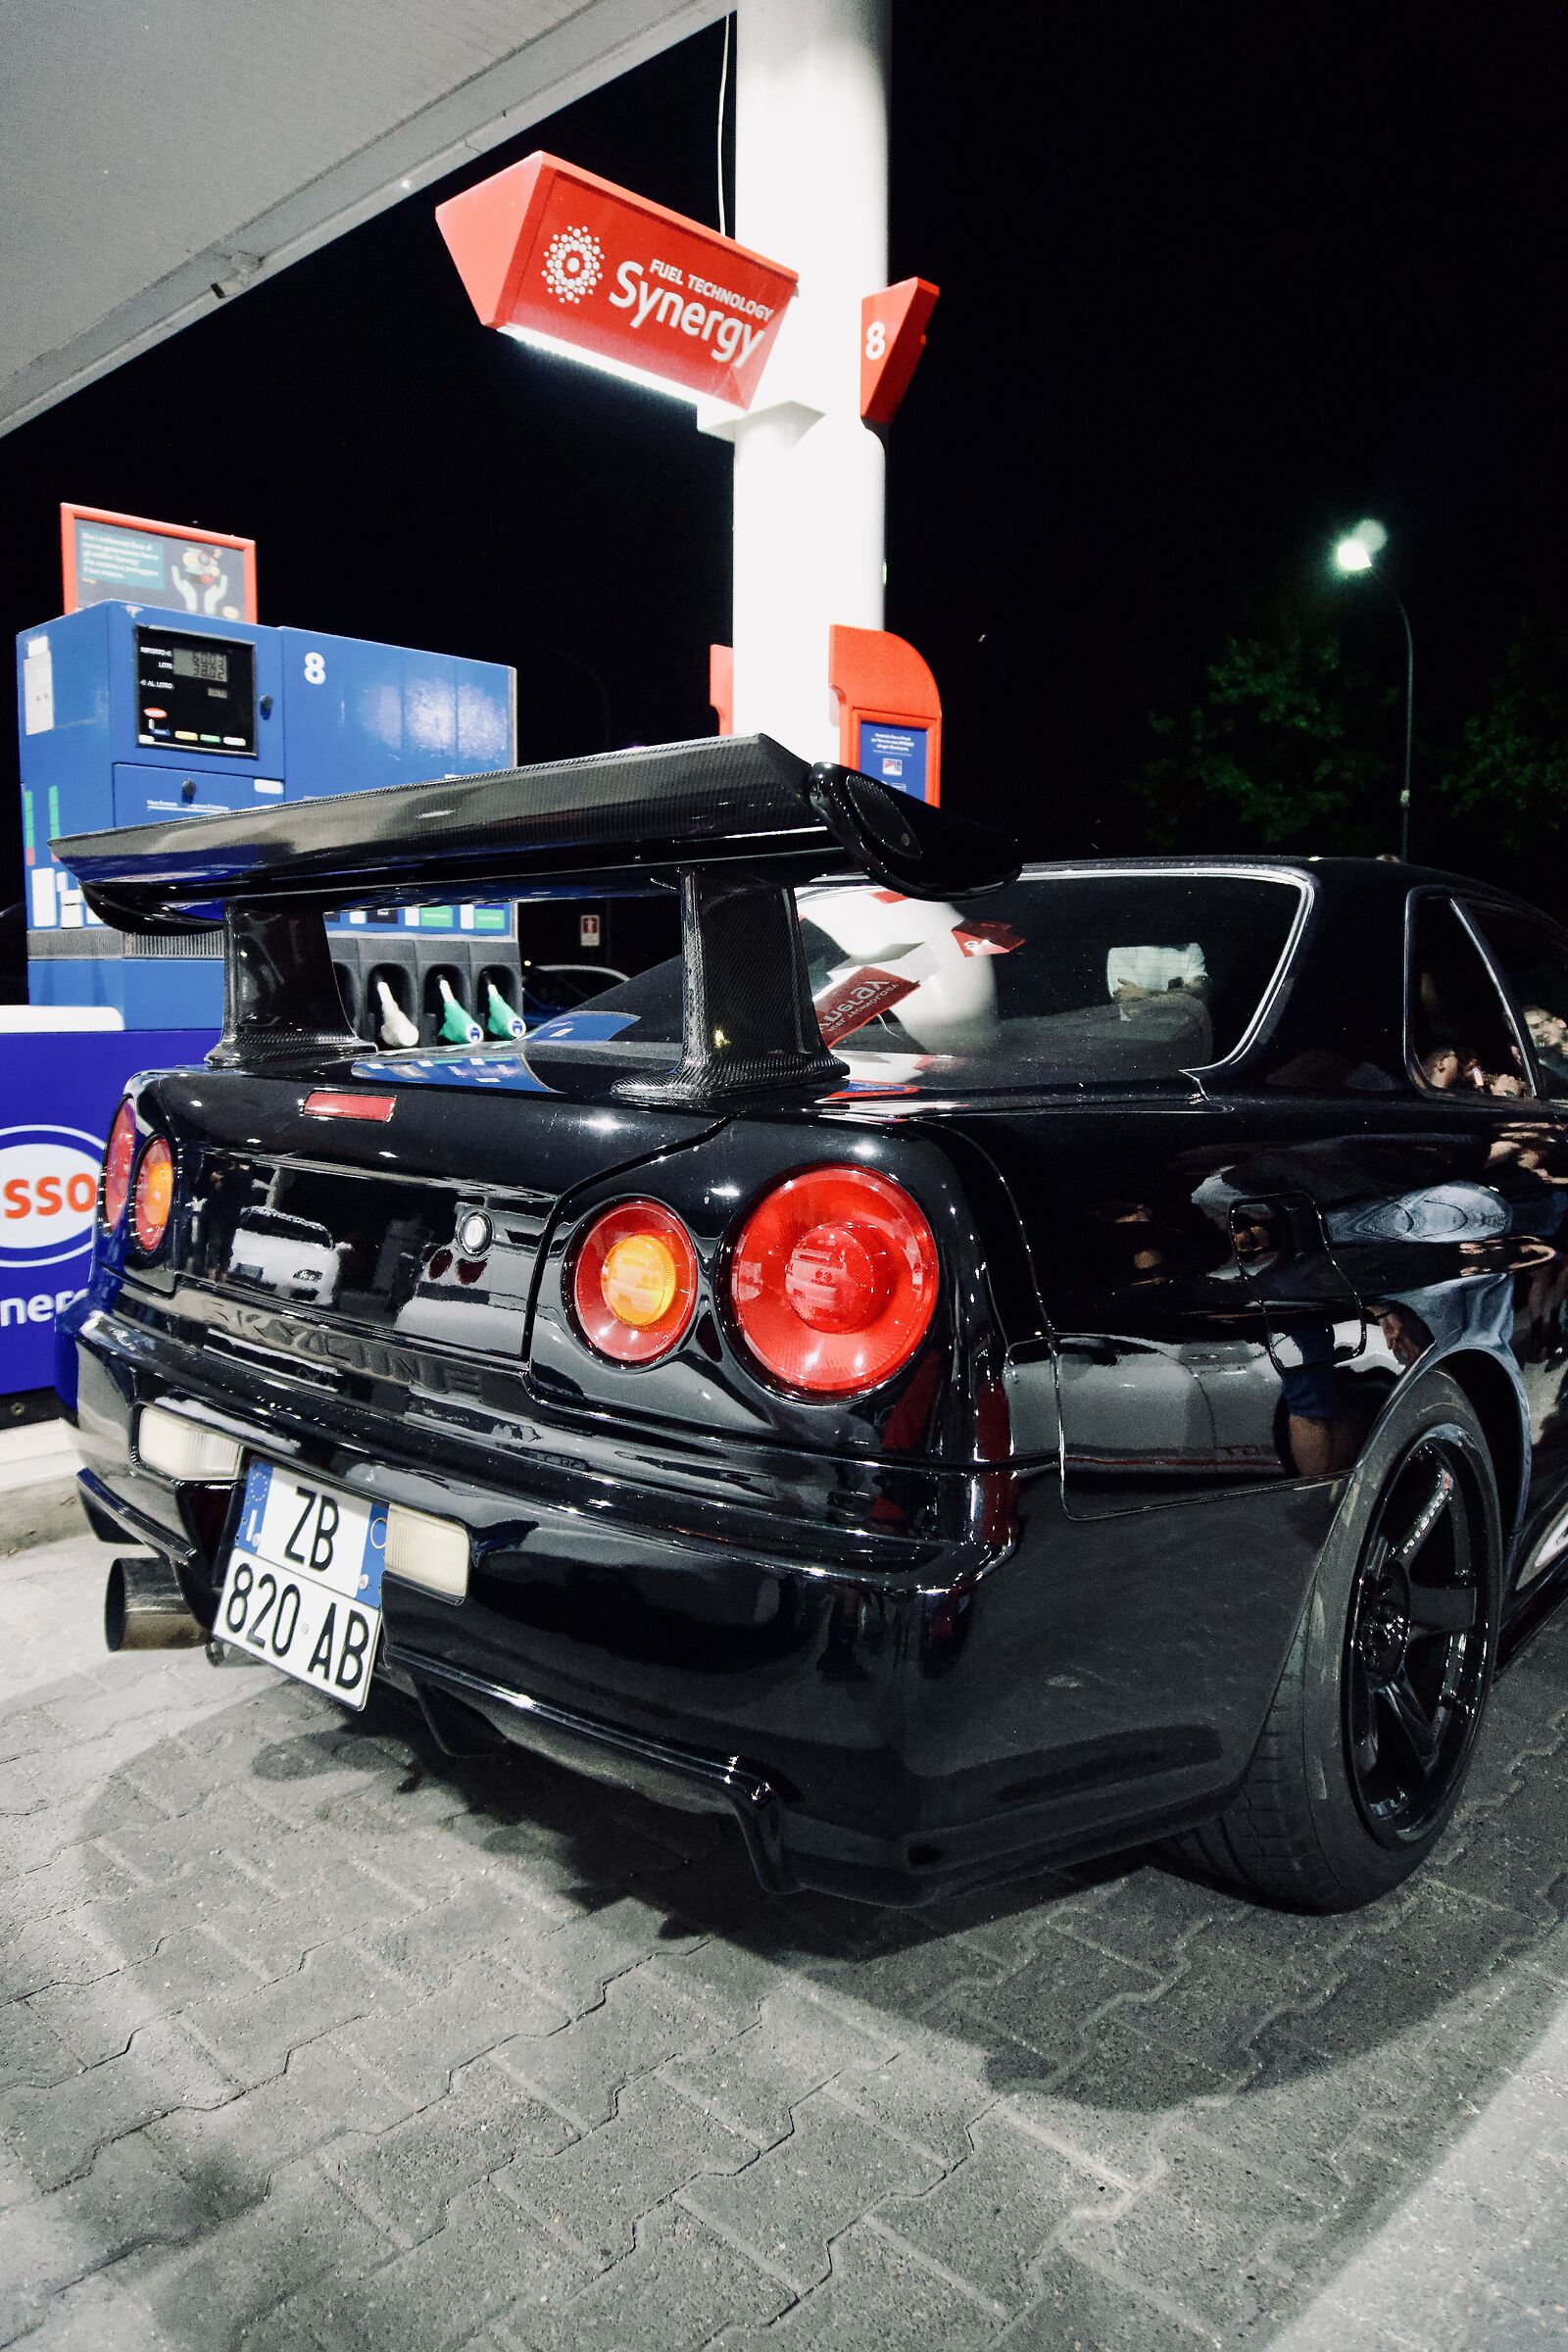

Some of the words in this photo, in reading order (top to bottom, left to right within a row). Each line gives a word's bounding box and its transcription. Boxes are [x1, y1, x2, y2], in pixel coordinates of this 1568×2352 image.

[609, 260, 766, 368] Synergy
[649, 259, 683, 285] FUEL
[687, 273, 774, 321] TECHNOLOGY
[865, 321, 886, 361] 8
[304, 652, 326, 685] 8
[3, 1173, 97, 1219] SSO
[200, 1298, 483, 1398] SKYLINE
[283, 1486, 339, 1572] ZB
[226, 1562, 301, 1658] 820
[306, 1601, 369, 1690] AB
